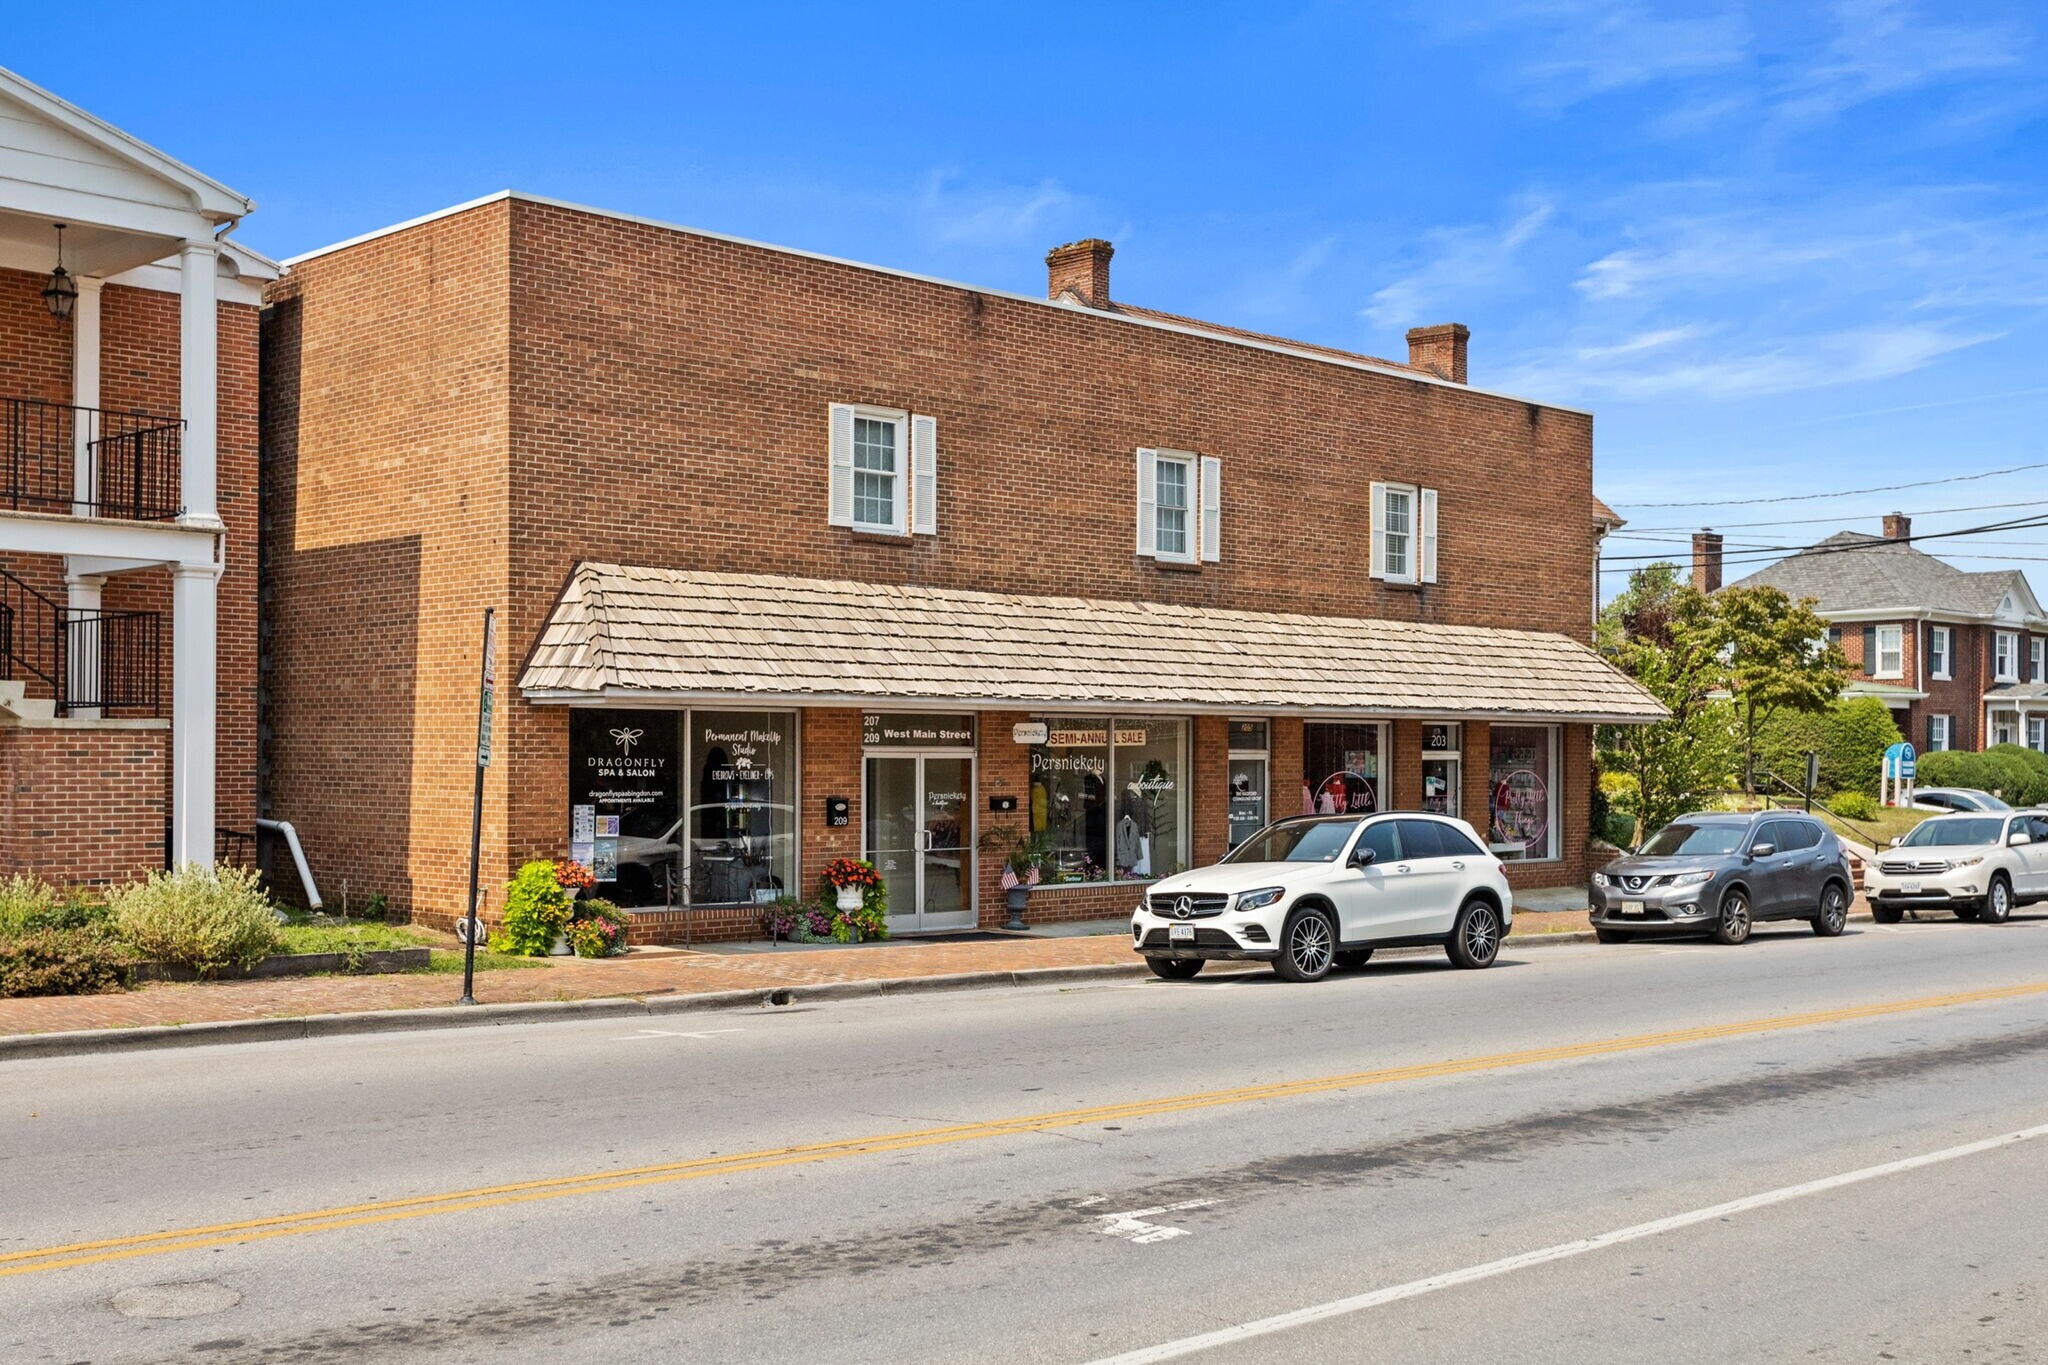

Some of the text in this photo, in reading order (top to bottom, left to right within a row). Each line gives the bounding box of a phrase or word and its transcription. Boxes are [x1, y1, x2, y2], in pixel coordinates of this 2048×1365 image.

[864, 716, 880, 726] 207
[705, 728, 748, 743] Permanent
[864, 729, 972, 743] 209 West Main Street
[1050, 732, 1143, 745] SEMI-ANNUL SALE
[1431, 735, 1447, 747] 203
[731, 742, 757, 756] Studio
[588, 757, 665, 768] DRAGONFLY
[1032, 753, 1105, 774] Persnickety
[598, 769, 656, 777] SPA & SALON
[834, 816, 848, 826] 209
